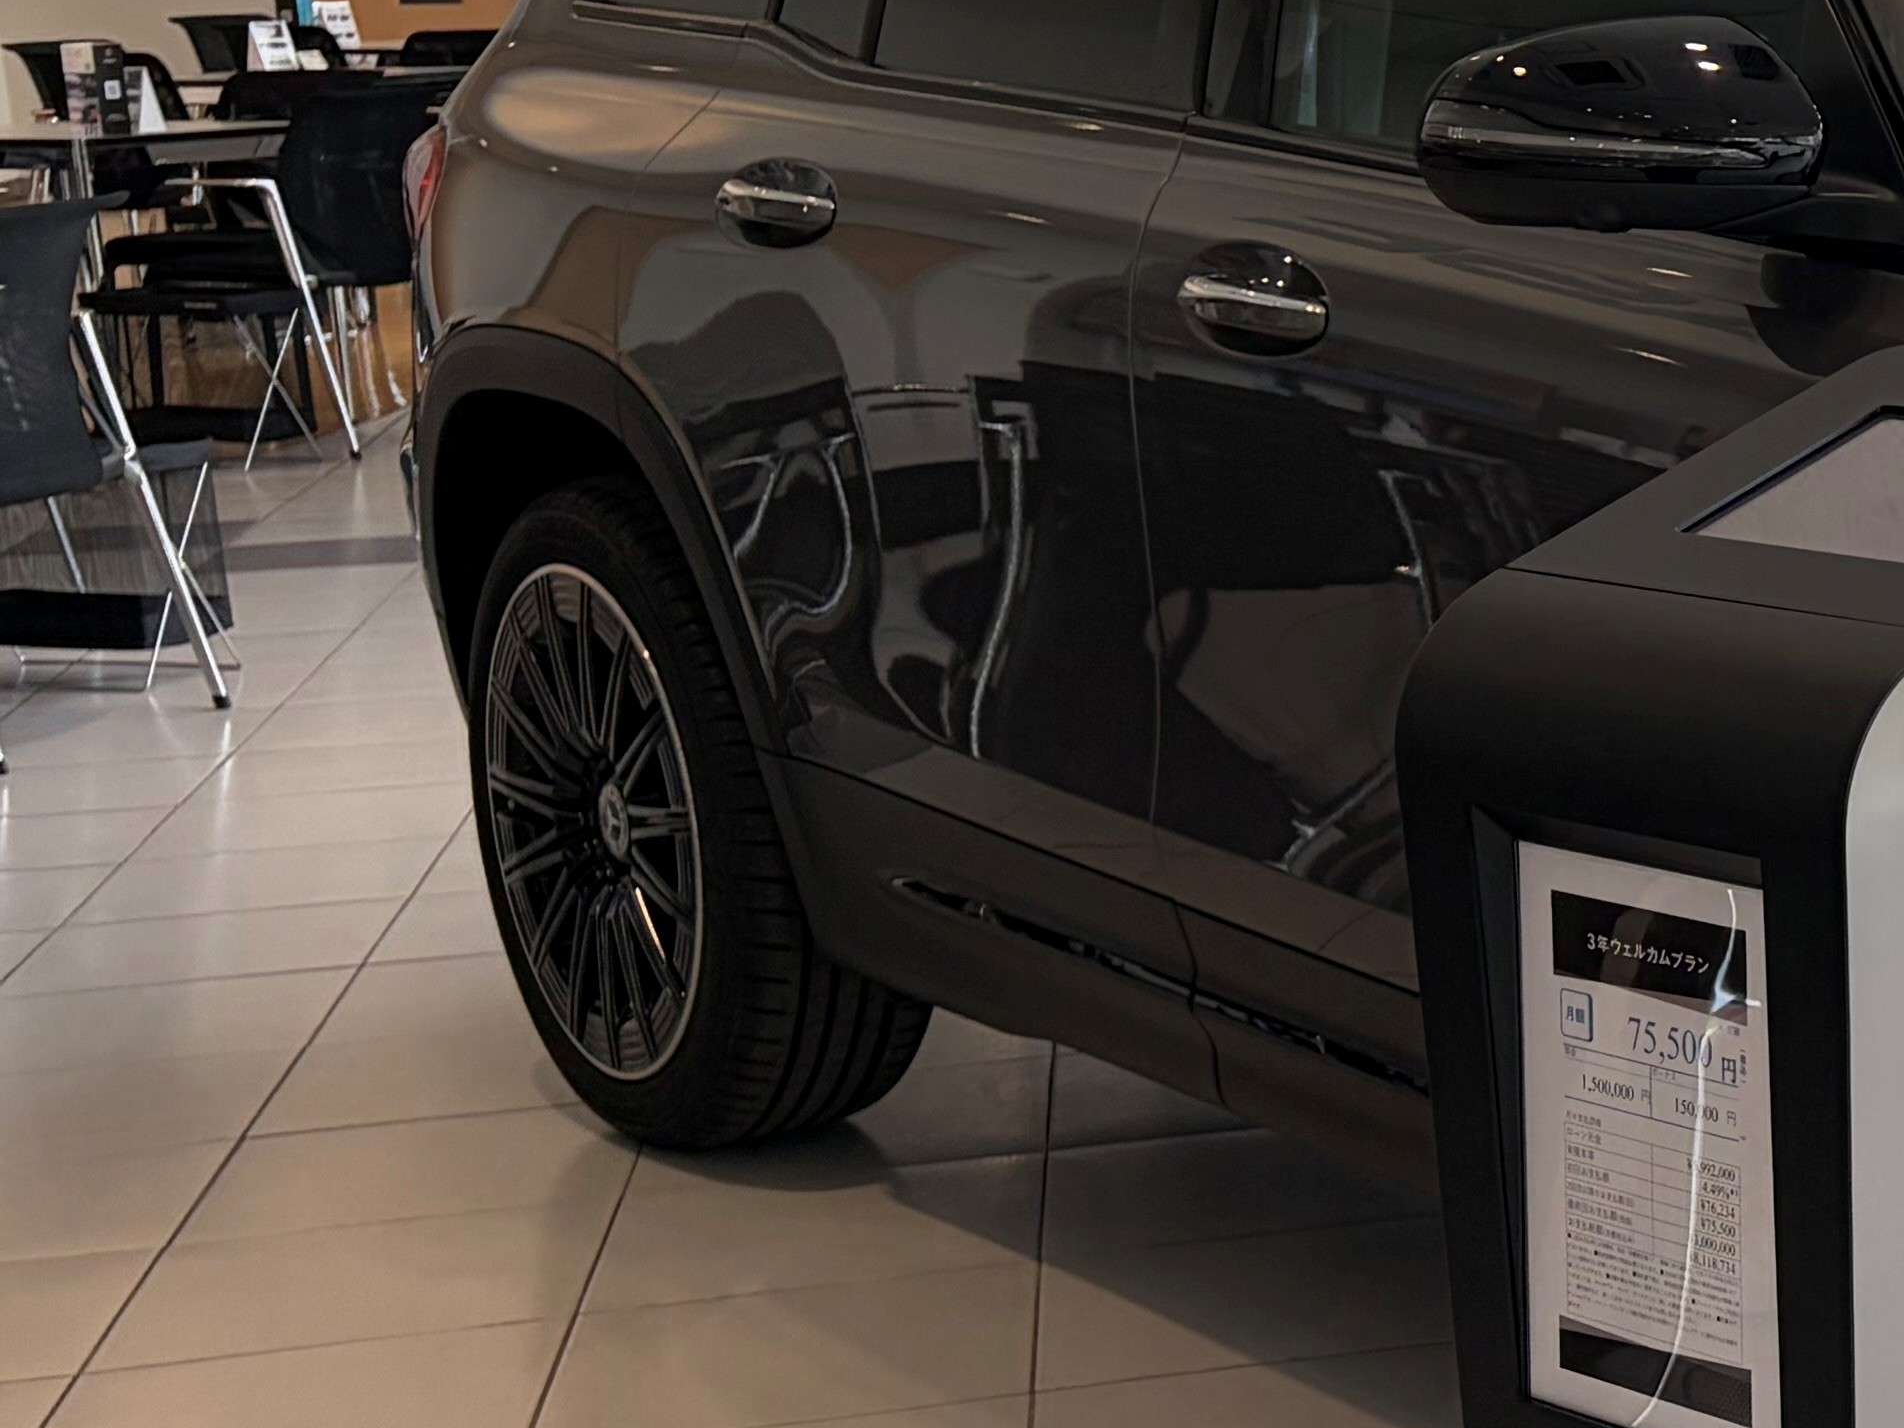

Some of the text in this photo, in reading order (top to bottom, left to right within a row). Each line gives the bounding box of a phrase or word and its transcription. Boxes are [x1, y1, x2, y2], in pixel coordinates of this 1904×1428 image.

[1627, 1016, 1713, 1069] 75,500
[1721, 1056, 1737, 1085] 円
[1582, 1073, 1635, 1102] 1,500,000
[1674, 1097, 1720, 1123] 150,00
